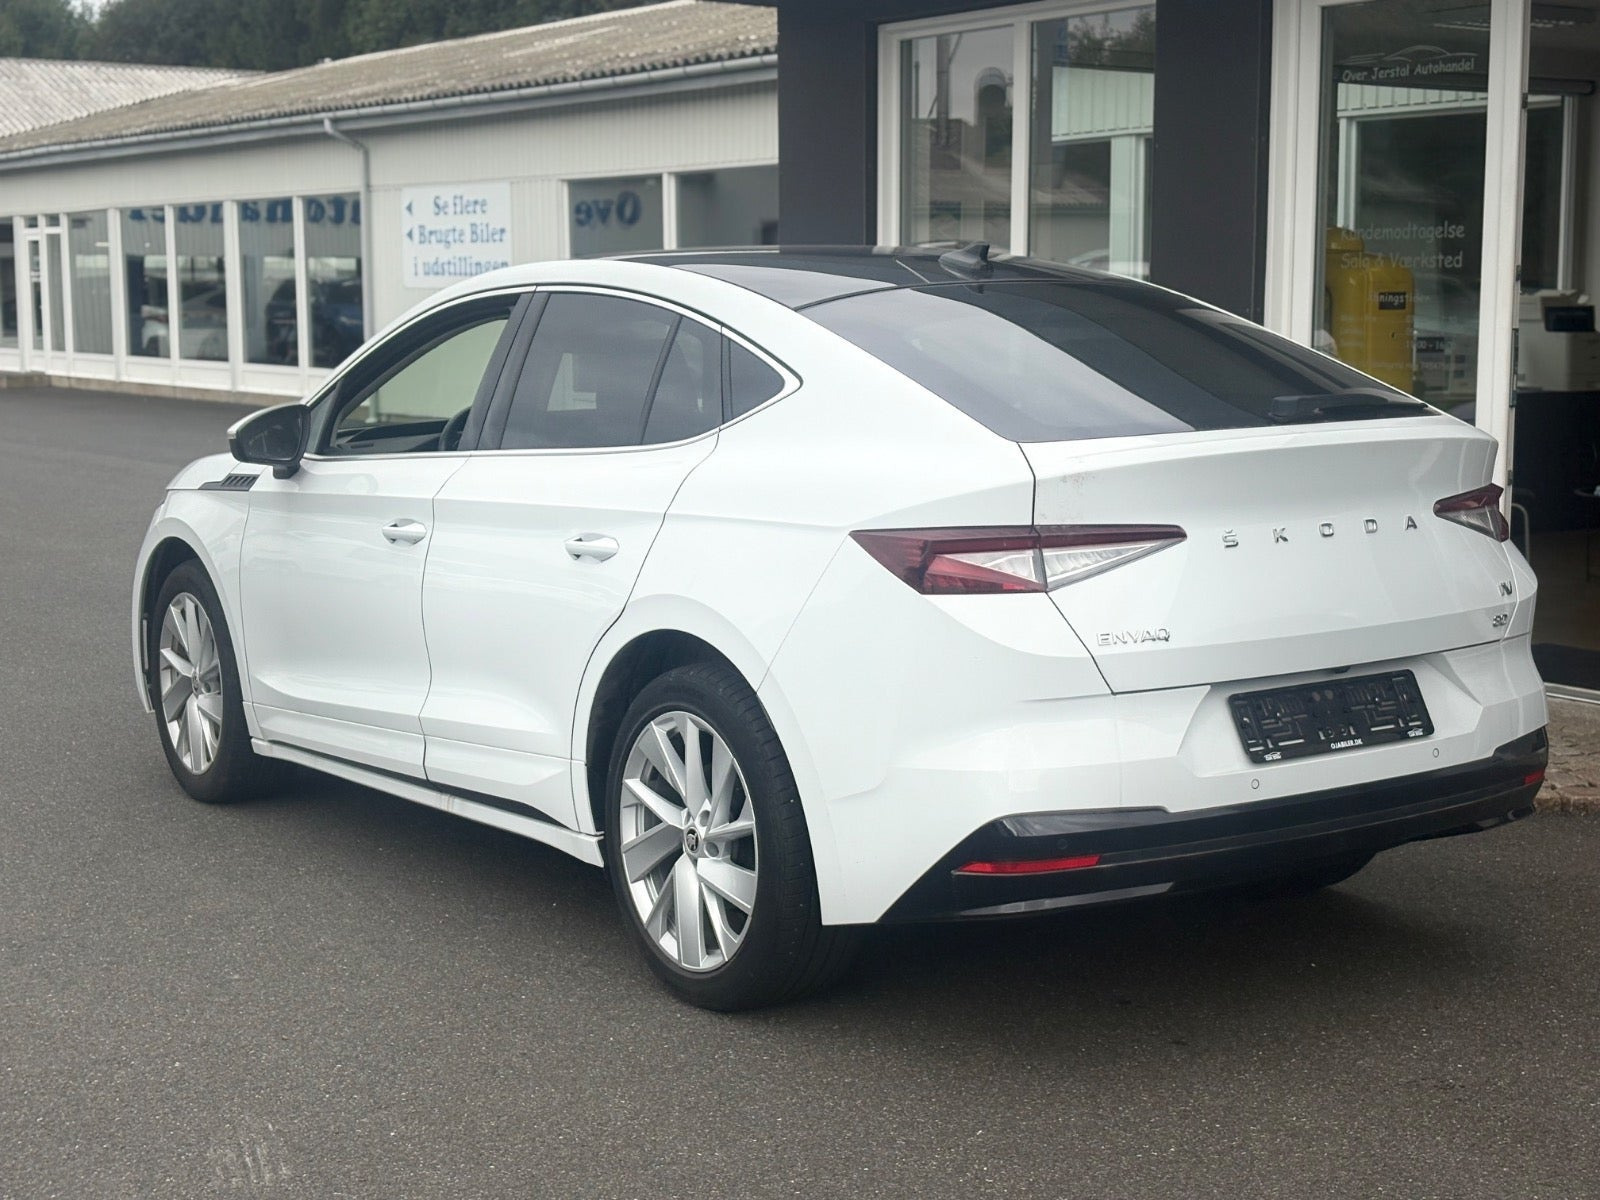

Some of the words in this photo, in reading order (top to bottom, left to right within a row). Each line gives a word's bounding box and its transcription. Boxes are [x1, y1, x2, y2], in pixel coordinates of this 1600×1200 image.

[1342, 69, 1368, 82] Over
[1371, 65, 1410, 80] Jerstal
[1413, 58, 1475, 75] Autohandel
[433, 196, 450, 215] Se
[452, 195, 488, 215] flere
[418, 225, 466, 248] Brugte
[469, 223, 507, 243] Biler
[1341, 252, 1370, 272] Salg
[1390, 251, 1463, 269] Værksted
[1223, 513, 1418, 548] ŠKODA
